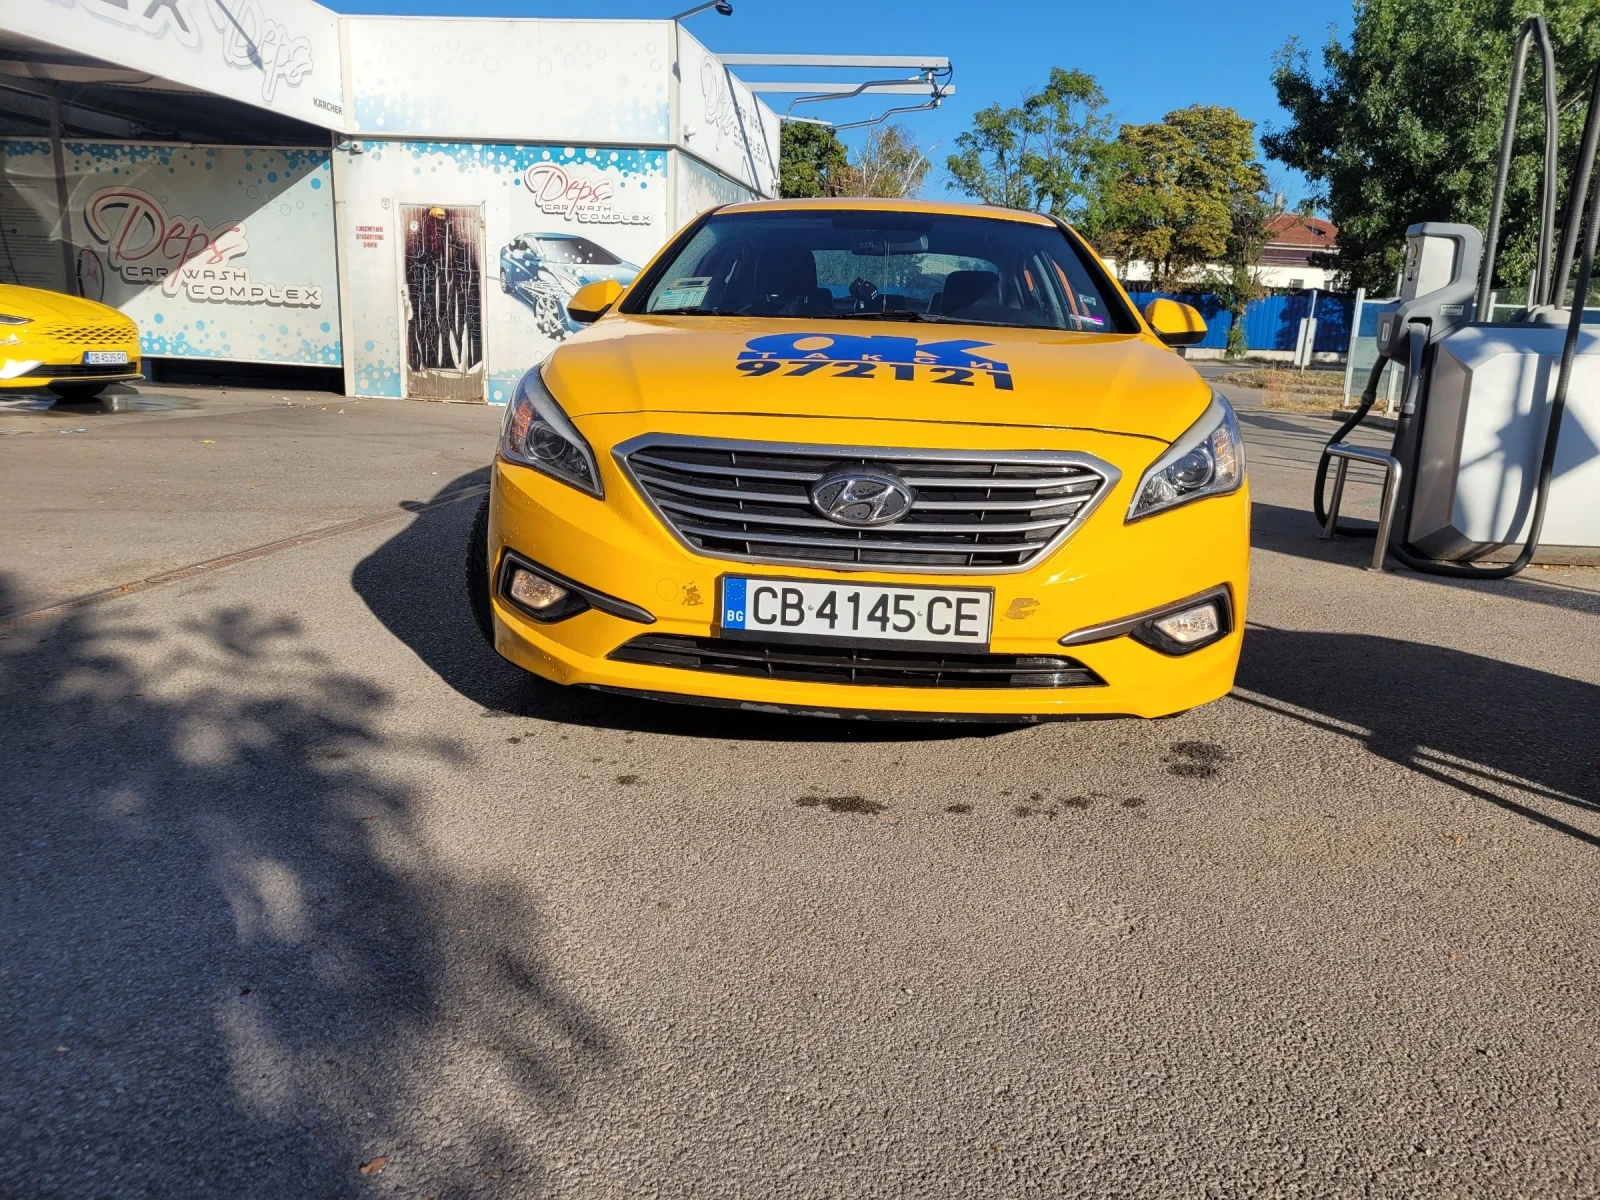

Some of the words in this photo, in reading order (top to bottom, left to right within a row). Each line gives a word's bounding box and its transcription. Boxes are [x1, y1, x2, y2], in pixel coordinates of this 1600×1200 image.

[528, 165, 612, 215] Deps
[580, 213, 651, 221] COMPLEX
[92, 192, 243, 288] Deps
[126, 266, 169, 278] CAR
[181, 268, 247, 281] WASH
[192, 285, 320, 301] COMPLEX
[735, 361, 1014, 391] 972121
[727, 610, 744, 622] BG
[753, 586, 805, 627] CB
[815, 590, 916, 633] 4145
[926, 596, 981, 637] CE
